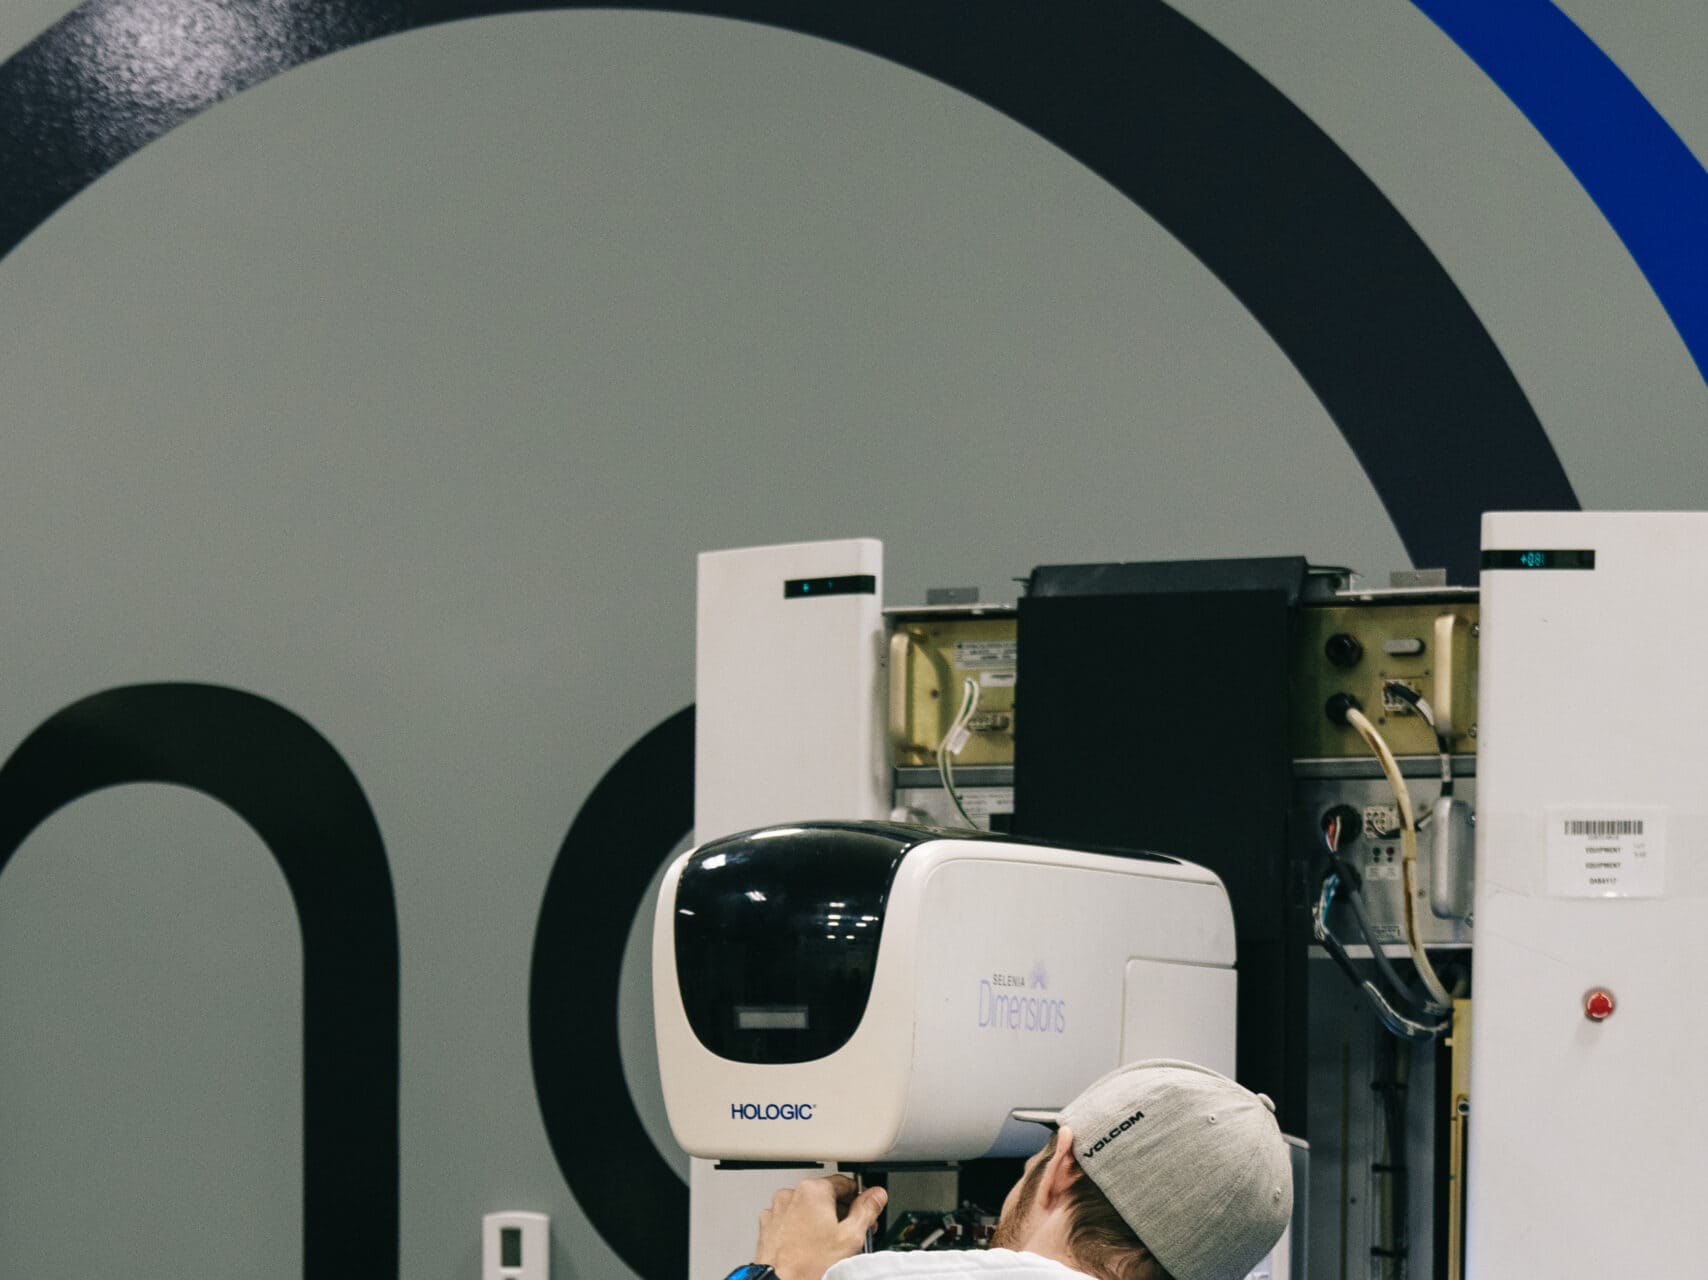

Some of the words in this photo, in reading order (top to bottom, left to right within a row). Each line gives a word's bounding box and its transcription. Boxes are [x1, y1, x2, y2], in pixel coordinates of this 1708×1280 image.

[992, 974, 1025, 987] SELENIA
[979, 979, 1066, 1035] Dimensions
[731, 1104, 813, 1120] HOLOGIC
[1083, 1110, 1145, 1158] VOLCOM
